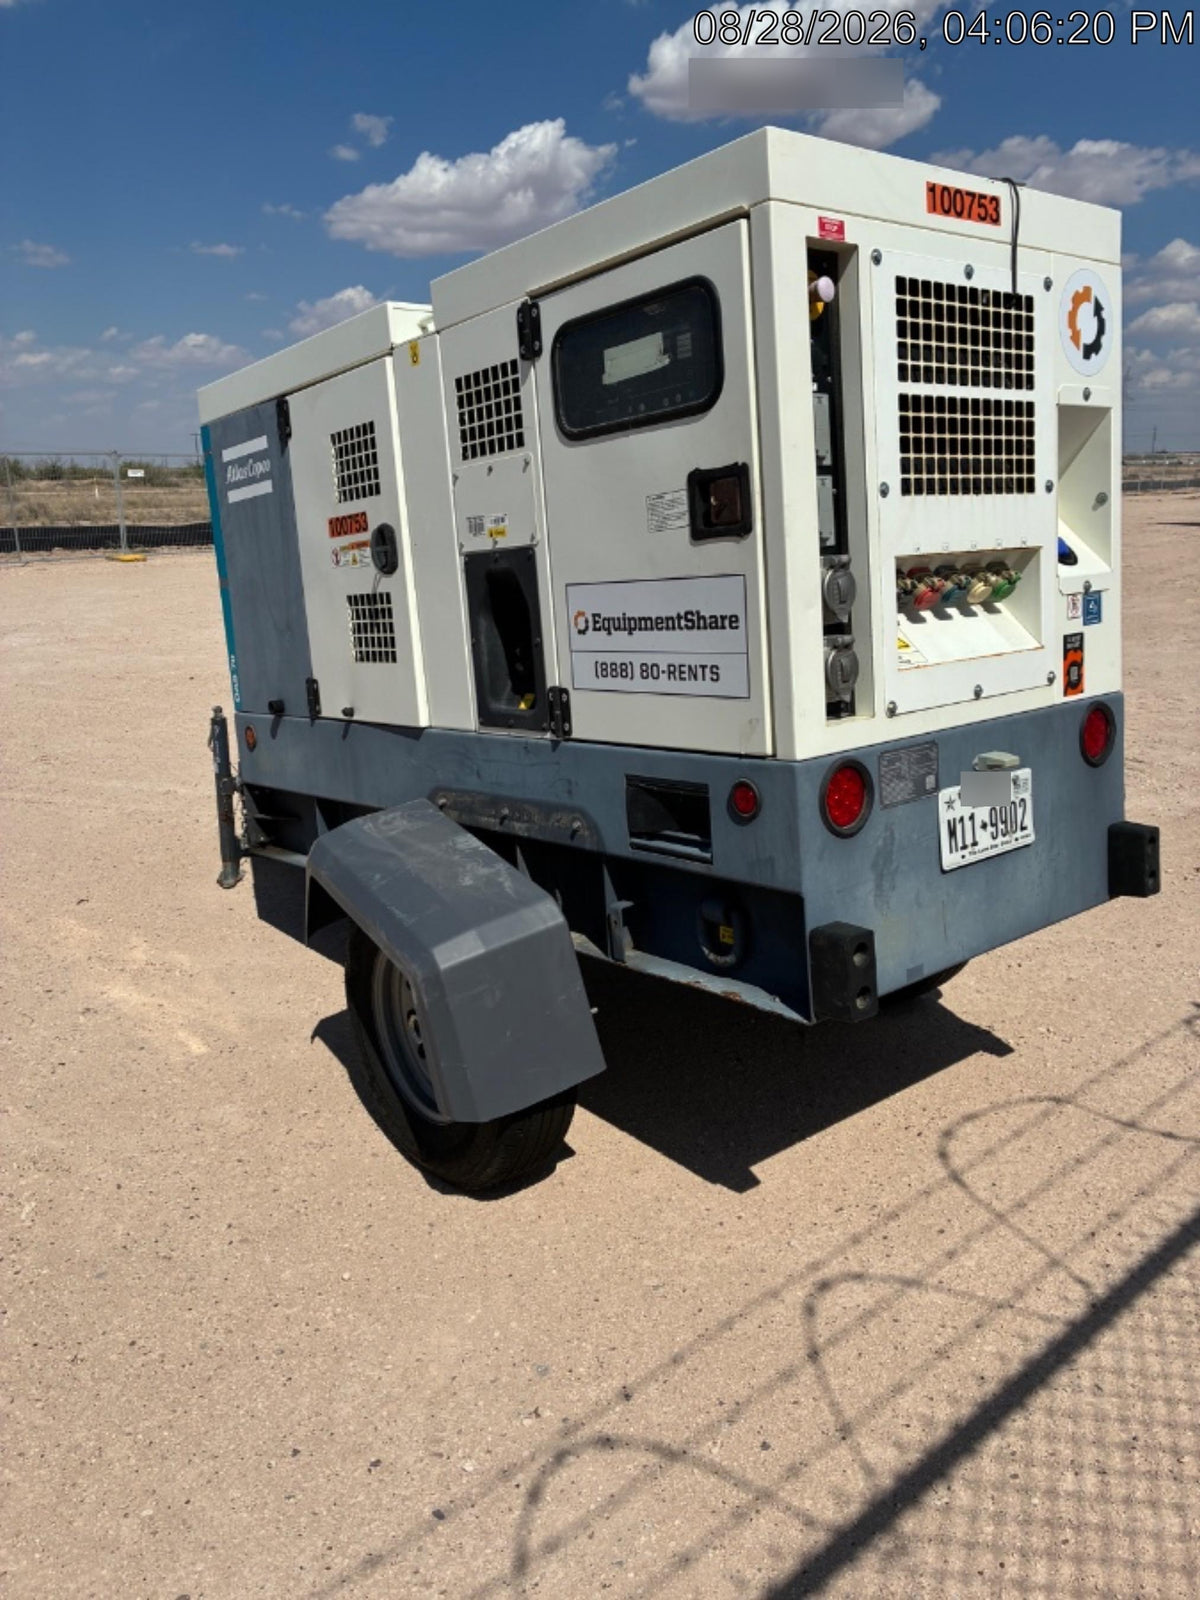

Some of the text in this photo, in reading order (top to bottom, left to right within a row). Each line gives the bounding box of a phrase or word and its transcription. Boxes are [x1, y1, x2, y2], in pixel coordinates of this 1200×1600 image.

[928, 183, 1000, 223] 100753
[329, 511, 368, 537] 100753
[591, 610, 740, 636] EquipmentShare
[594, 661, 720, 682] (888) 80-RENTS
